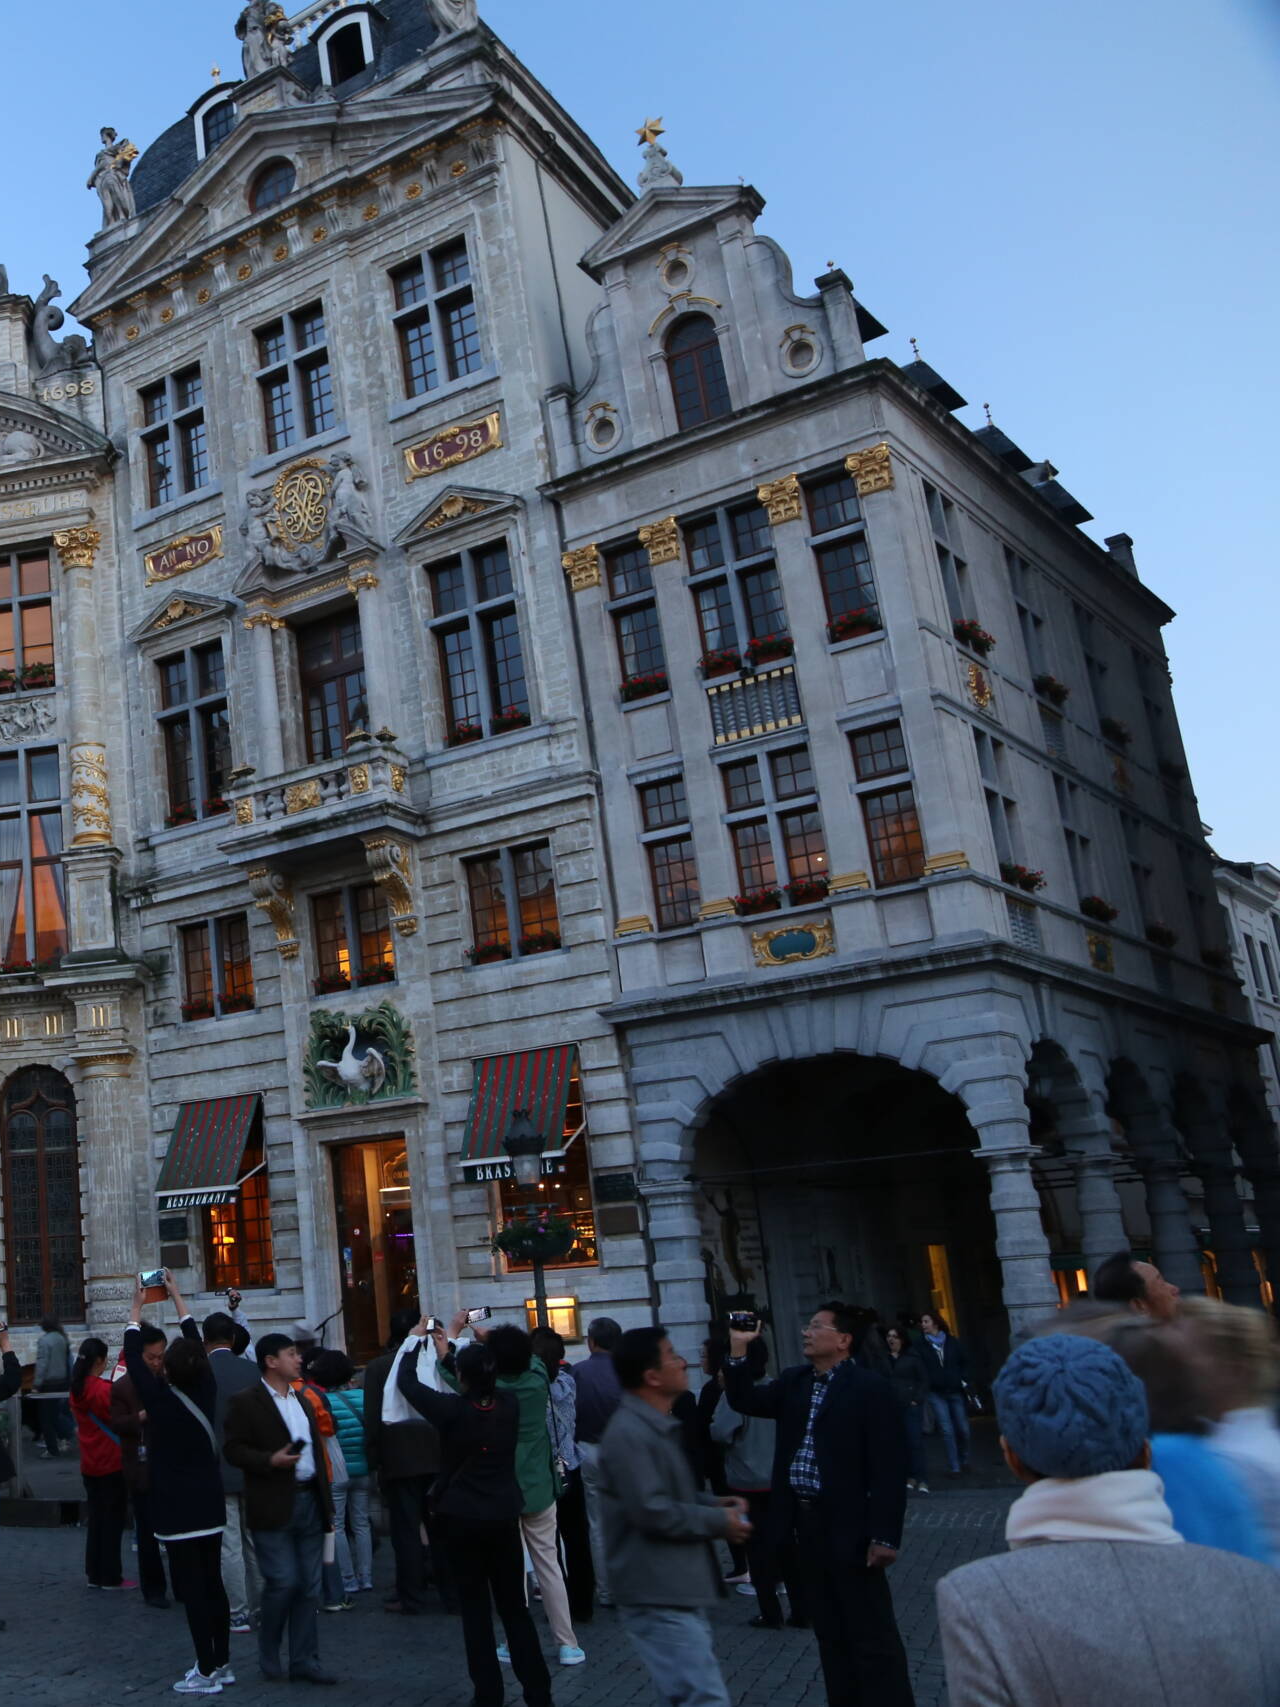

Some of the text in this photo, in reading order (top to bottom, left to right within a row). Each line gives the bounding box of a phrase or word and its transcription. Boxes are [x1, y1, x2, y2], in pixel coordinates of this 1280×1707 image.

[40, 379, 95, 401] 1698
[423, 429, 482, 466] 1698
[476, 1158, 554, 1181] BRASIE
[166, 1191, 227, 1209] RESTAURANT
